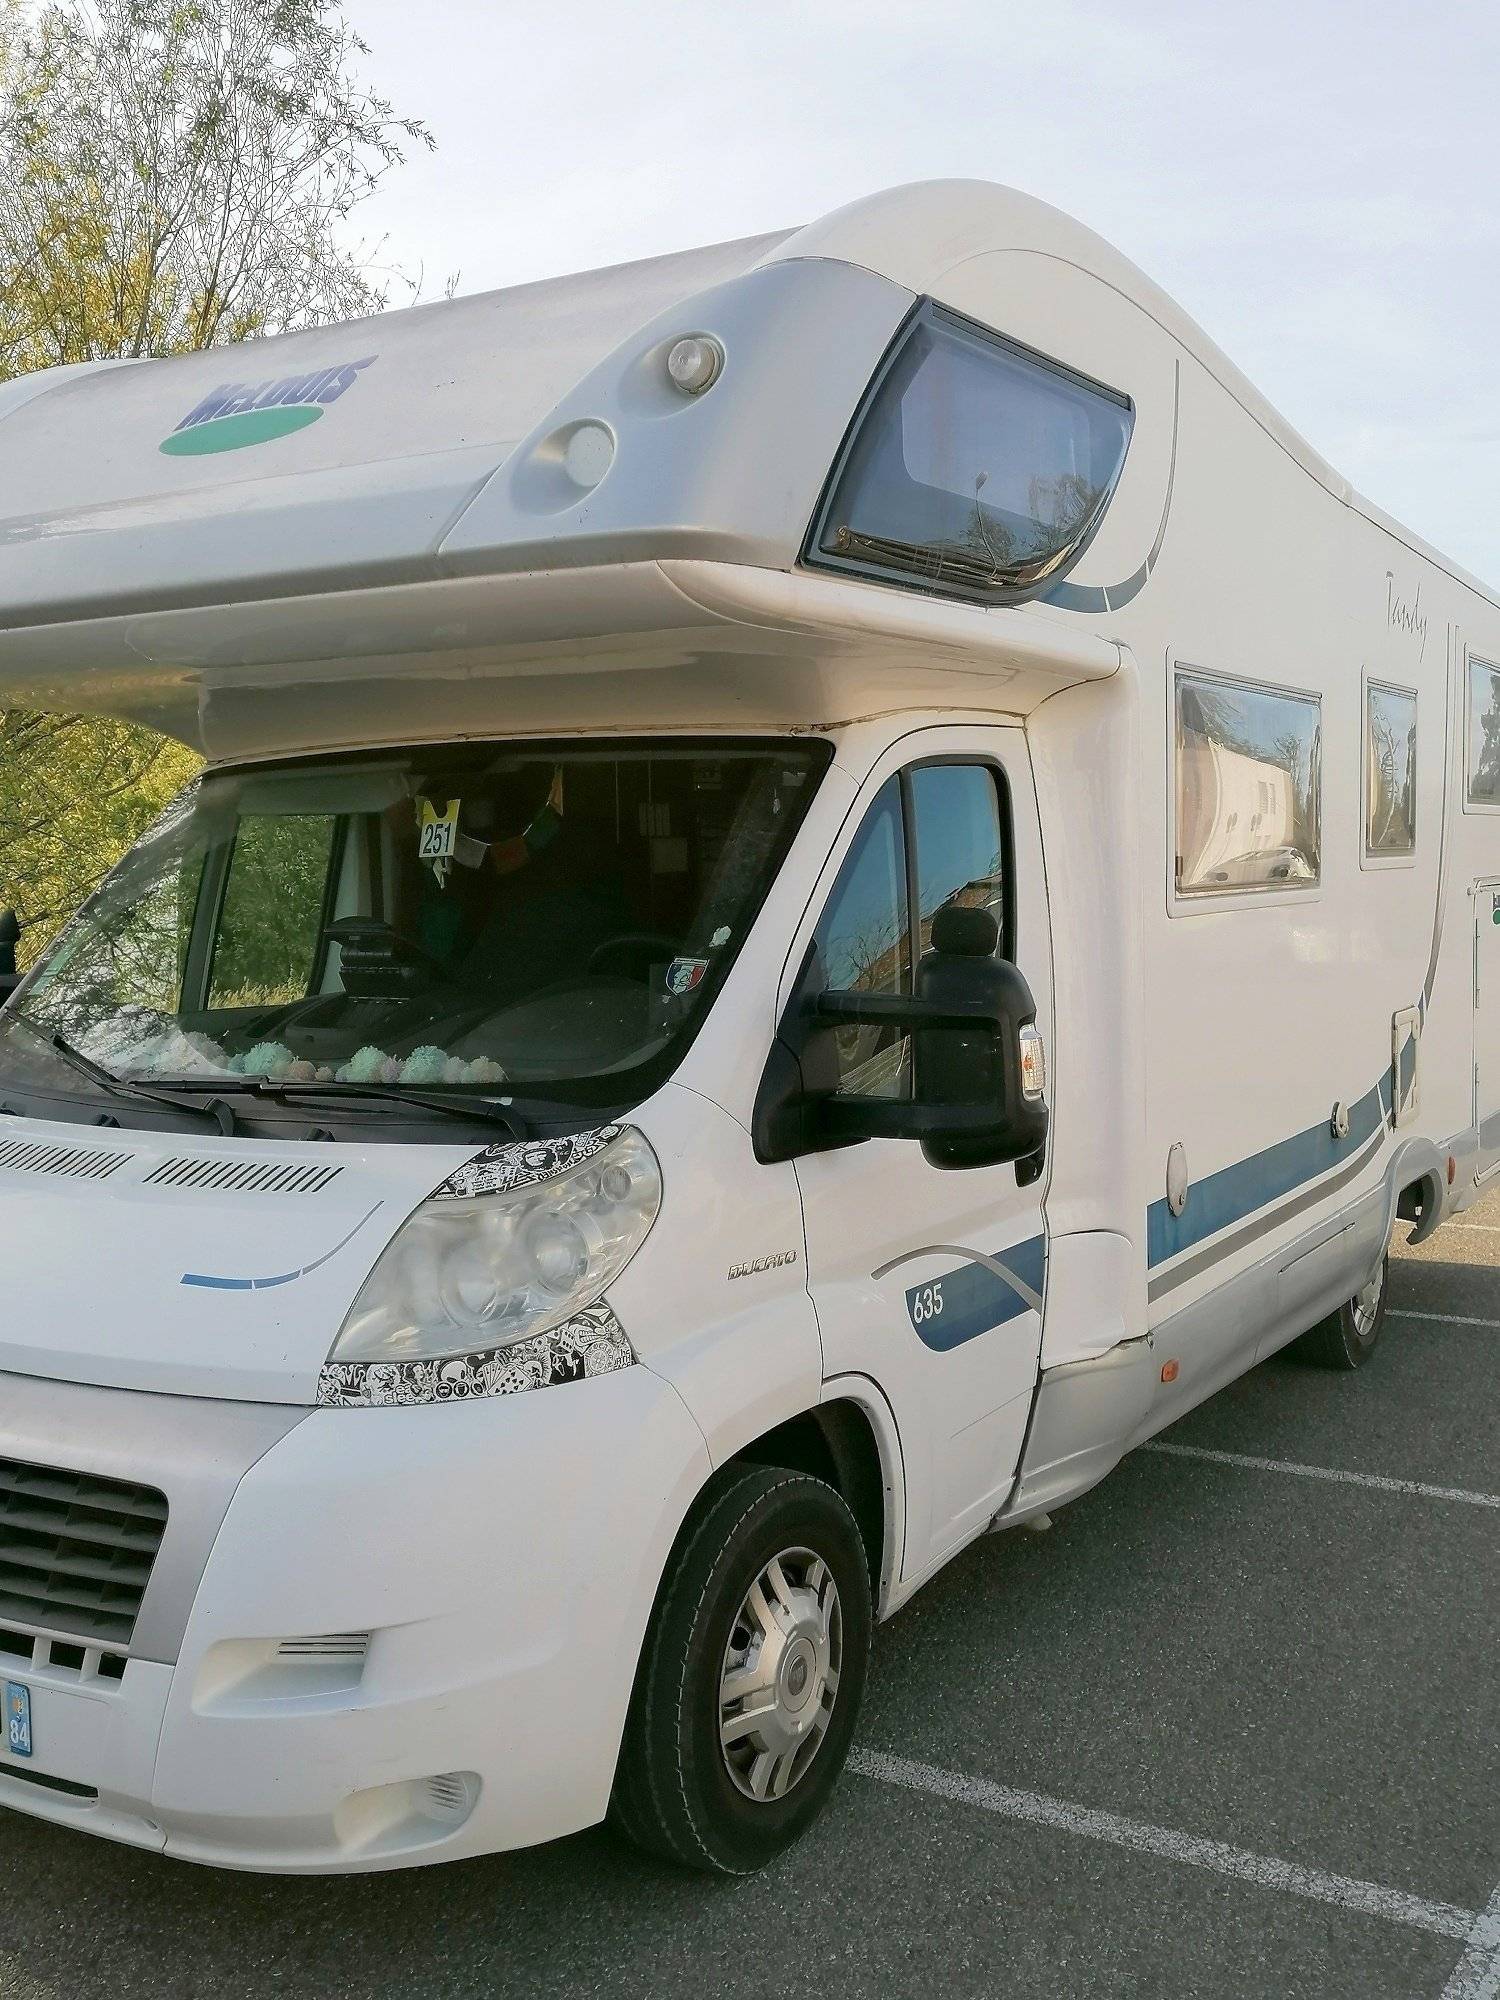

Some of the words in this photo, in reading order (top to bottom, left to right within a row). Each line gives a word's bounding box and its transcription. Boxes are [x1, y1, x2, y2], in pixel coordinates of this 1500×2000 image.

[422, 822, 452, 854] 251
[727, 1250, 798, 1281] DUCATO
[913, 1282, 944, 1324] 635
[10, 1719, 29, 1747] 84
